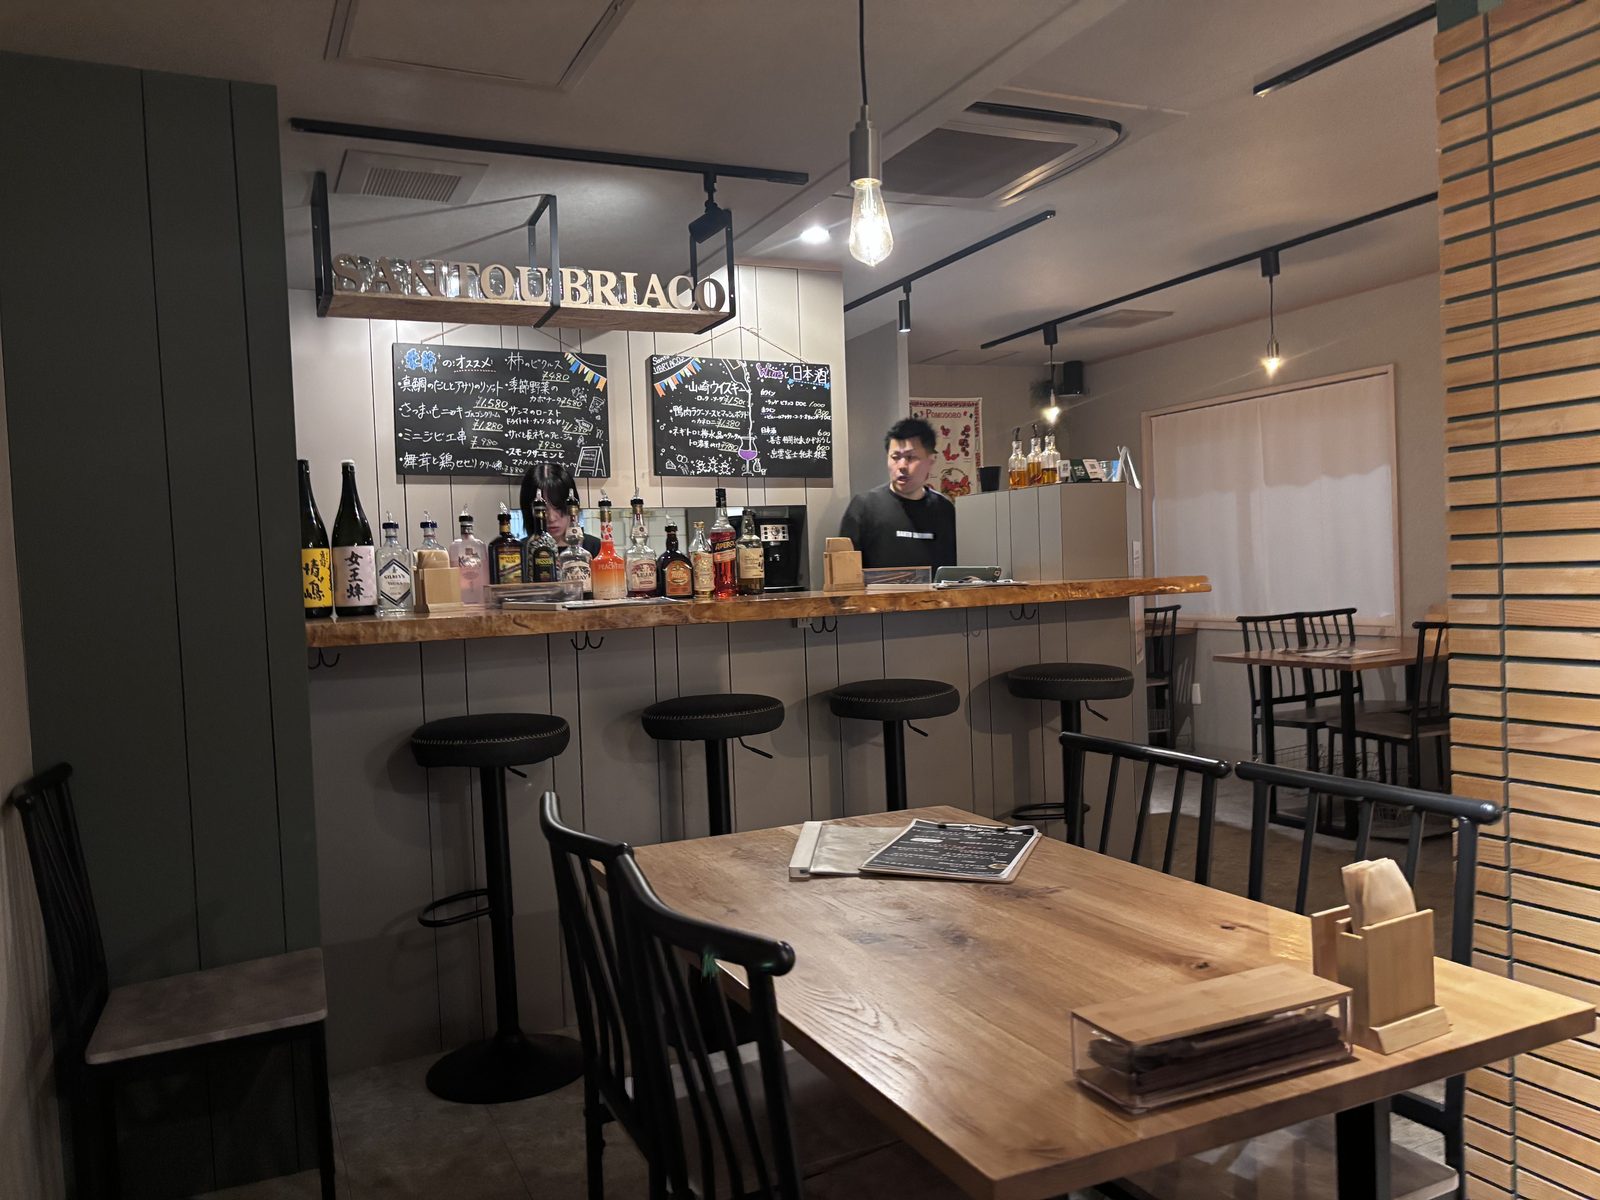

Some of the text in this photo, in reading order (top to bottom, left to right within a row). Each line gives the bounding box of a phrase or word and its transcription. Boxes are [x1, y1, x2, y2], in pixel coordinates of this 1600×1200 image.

[403, 427, 467, 445] ミニジビエ串
[344, 551, 365, 601] 女王蜂
